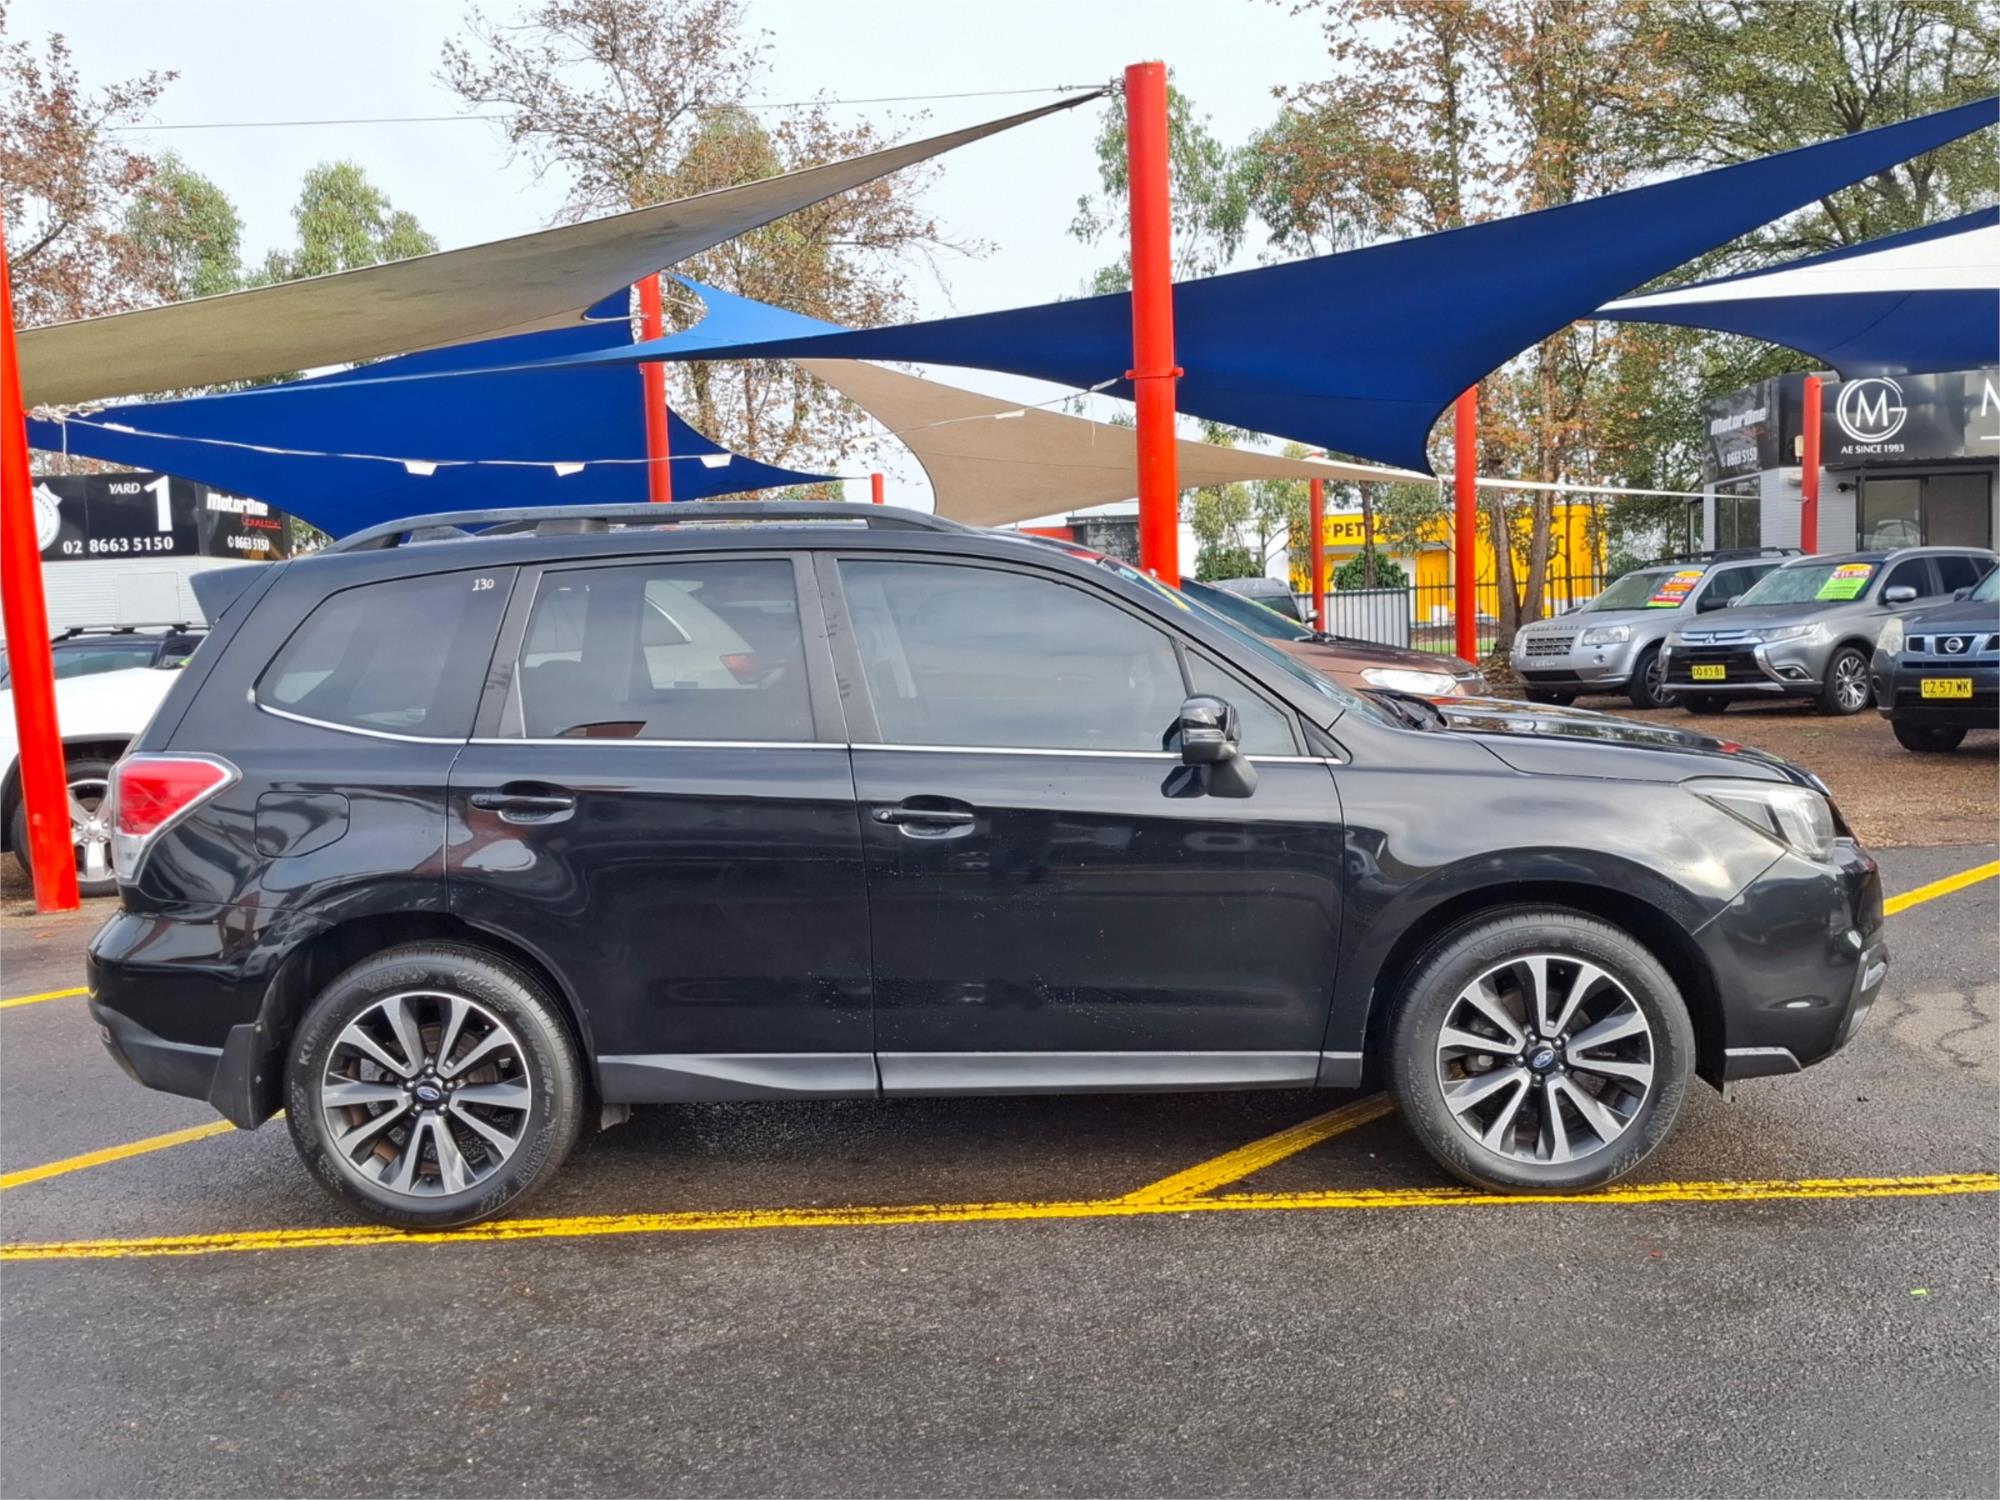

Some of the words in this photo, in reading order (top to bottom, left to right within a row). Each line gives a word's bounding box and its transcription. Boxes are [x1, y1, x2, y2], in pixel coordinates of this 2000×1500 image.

[1855, 444, 1882, 454] SINCE
[1883, 443, 1905, 453] 1993
[108, 482, 141, 495] YARD
[143, 474, 173, 532] 1
[62, 541, 83, 555] 02
[89, 538, 130, 553] 8663
[132, 536, 174, 552] 5150
[472, 578, 495, 591] 130
